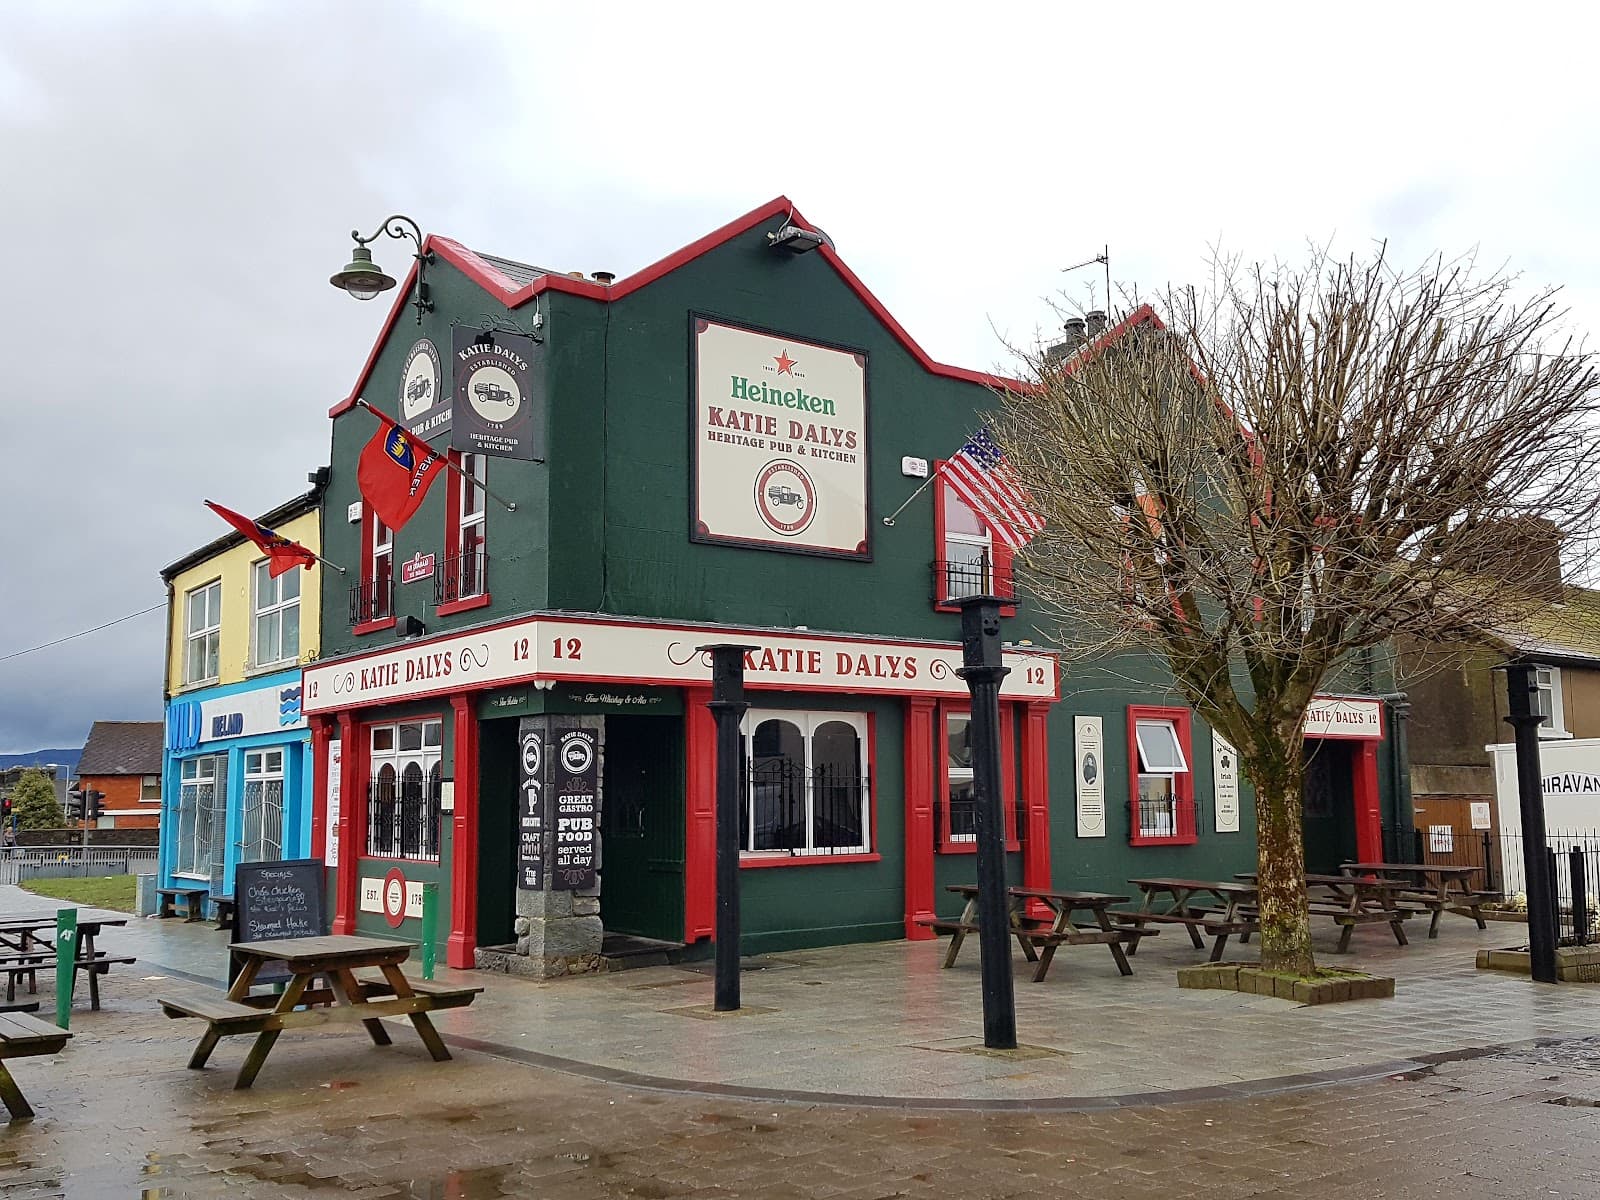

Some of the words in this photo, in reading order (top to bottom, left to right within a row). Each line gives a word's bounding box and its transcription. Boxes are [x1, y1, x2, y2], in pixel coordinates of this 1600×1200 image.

[458, 343, 491, 360] KATIE
[494, 345, 528, 371] DALYS
[469, 359, 516, 376] ESTABLISHED
[731, 375, 836, 416] Heineken
[411, 421, 424, 436] PUB
[425, 419, 430, 430] &
[431, 408, 452, 427] KITCH
[708, 406, 777, 436] KATIE
[789, 420, 857, 449] DALYS
[470, 433, 503, 443] HERITAGE
[504, 437, 518, 445] PUB
[484, 442, 513, 451] KITCHEN
[707, 430, 765, 449] HERITAGE
[769, 441, 793, 455] PUB
[798, 445, 806, 456] &
[811, 447, 857, 464] KITCHEN
[513, 638, 529, 661] 12
[552, 637, 582, 660] 12
[360, 668, 398, 691] KATIE
[406, 651, 453, 682] DALYS
[743, 647, 821, 674] KATIE
[836, 652, 917, 679] DALYS
[1026, 667, 1045, 684] 12
[308, 681, 318, 698] 12
[625, 695, 631, 703] &
[166, 701, 202, 750] WILD
[212, 713, 243, 737] IRELAND
[1336, 711, 1364, 724] DALYS
[1369, 715, 1376, 723] 12
[559, 796, 593, 804] GREAT
[557, 818, 593, 831] PUB
[522, 833, 540, 842] CRAFT
[558, 832, 593, 841] FOOD
[558, 844, 592, 854] served
[558, 855, 570, 865] all
[573, 854, 592, 866] day
[366, 889, 379, 901] EST.
[411, 893, 422, 905] 178
